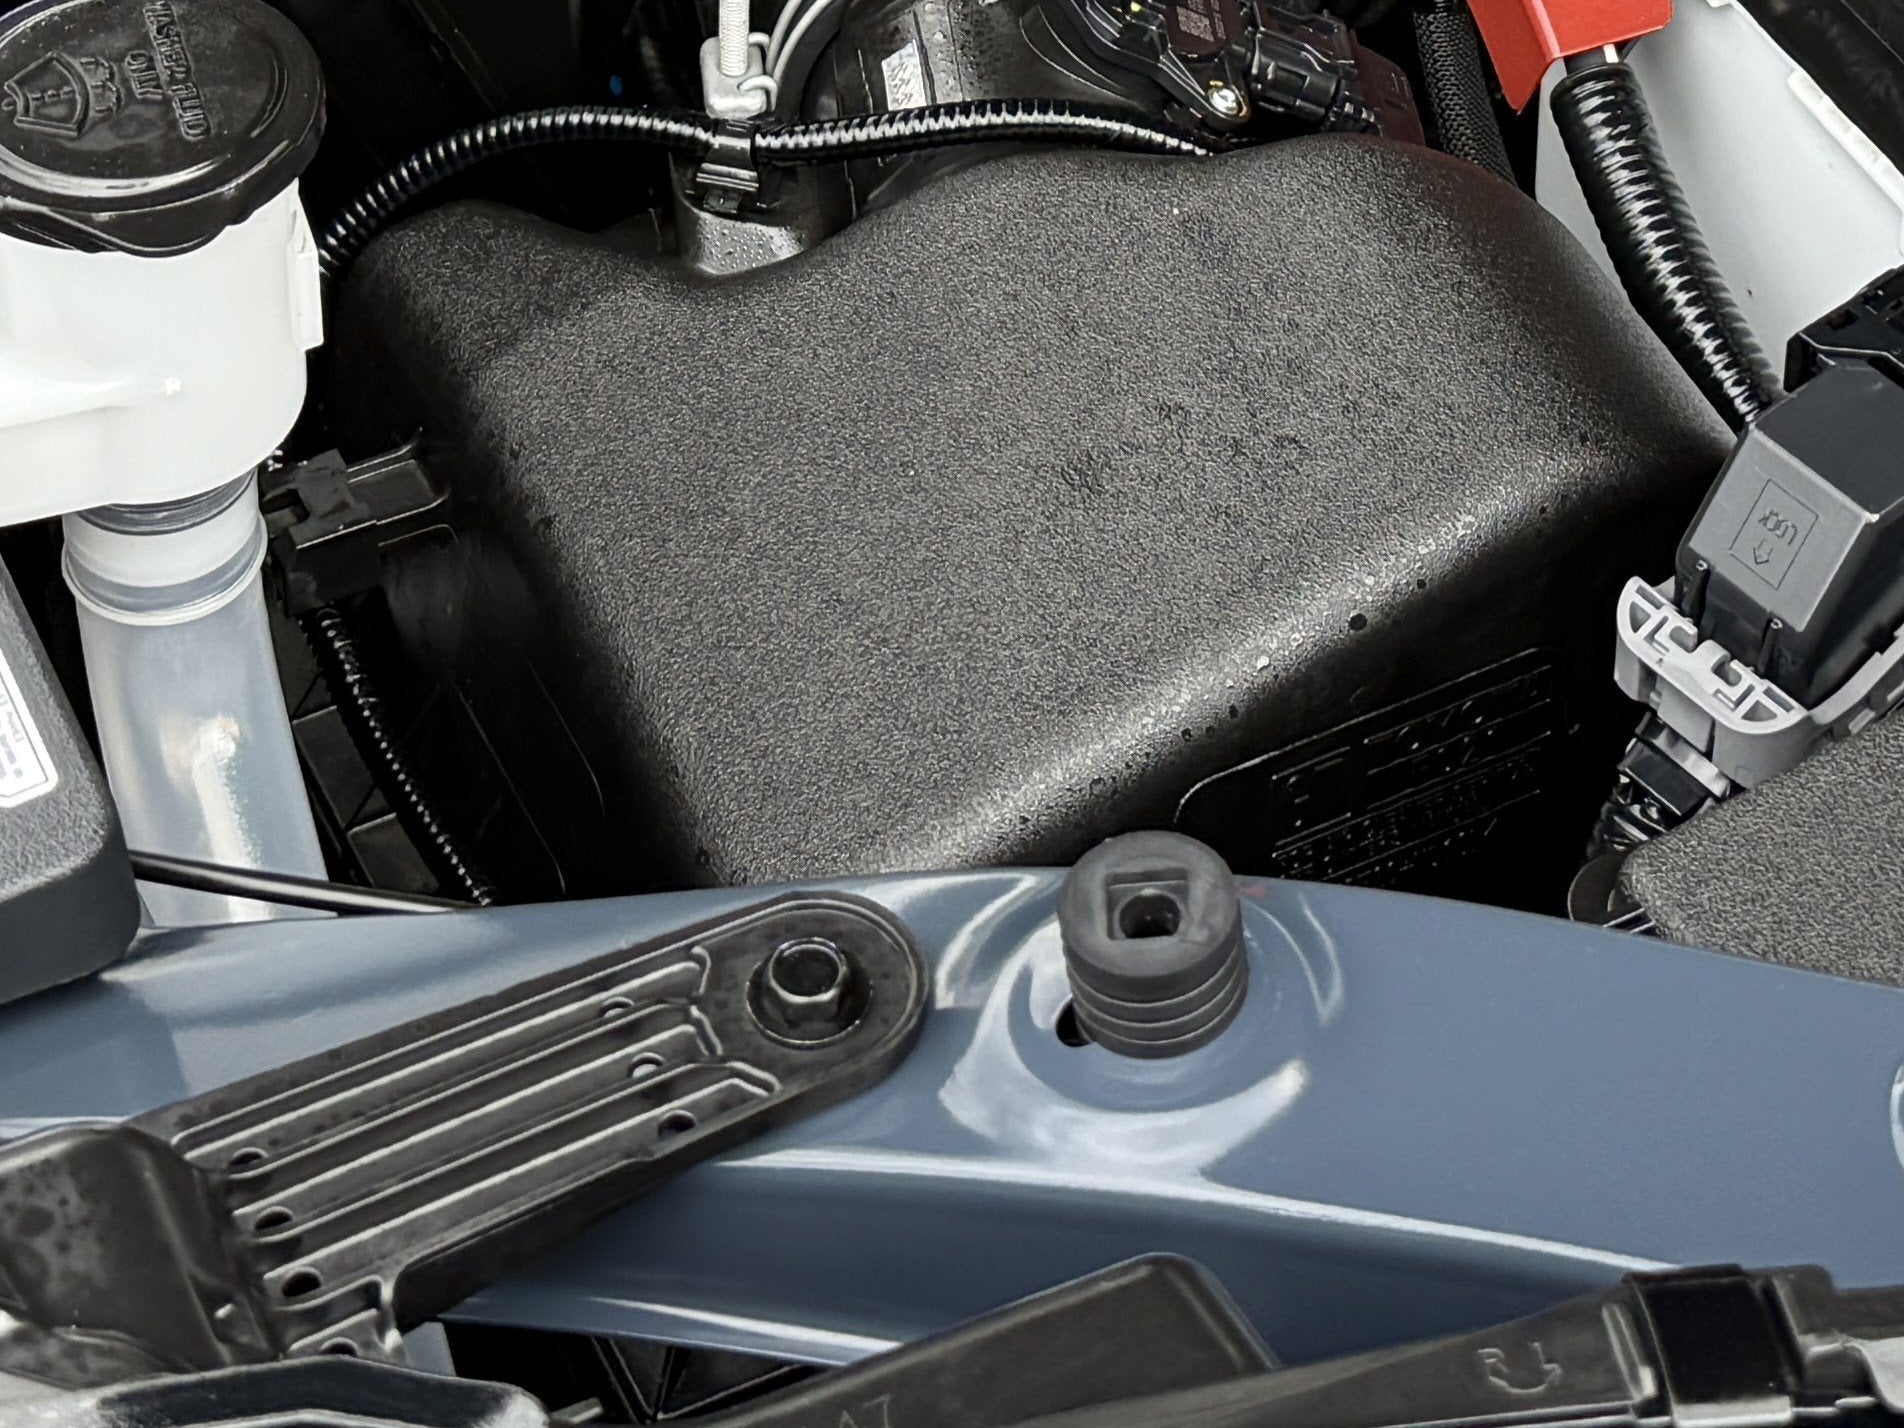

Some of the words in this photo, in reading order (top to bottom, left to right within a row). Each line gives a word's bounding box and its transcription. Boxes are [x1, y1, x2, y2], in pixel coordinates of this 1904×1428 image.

[125, 50, 163, 100] ONLY
[144, 2, 191, 77] WASHER
[171, 84, 211, 138] FLUID
